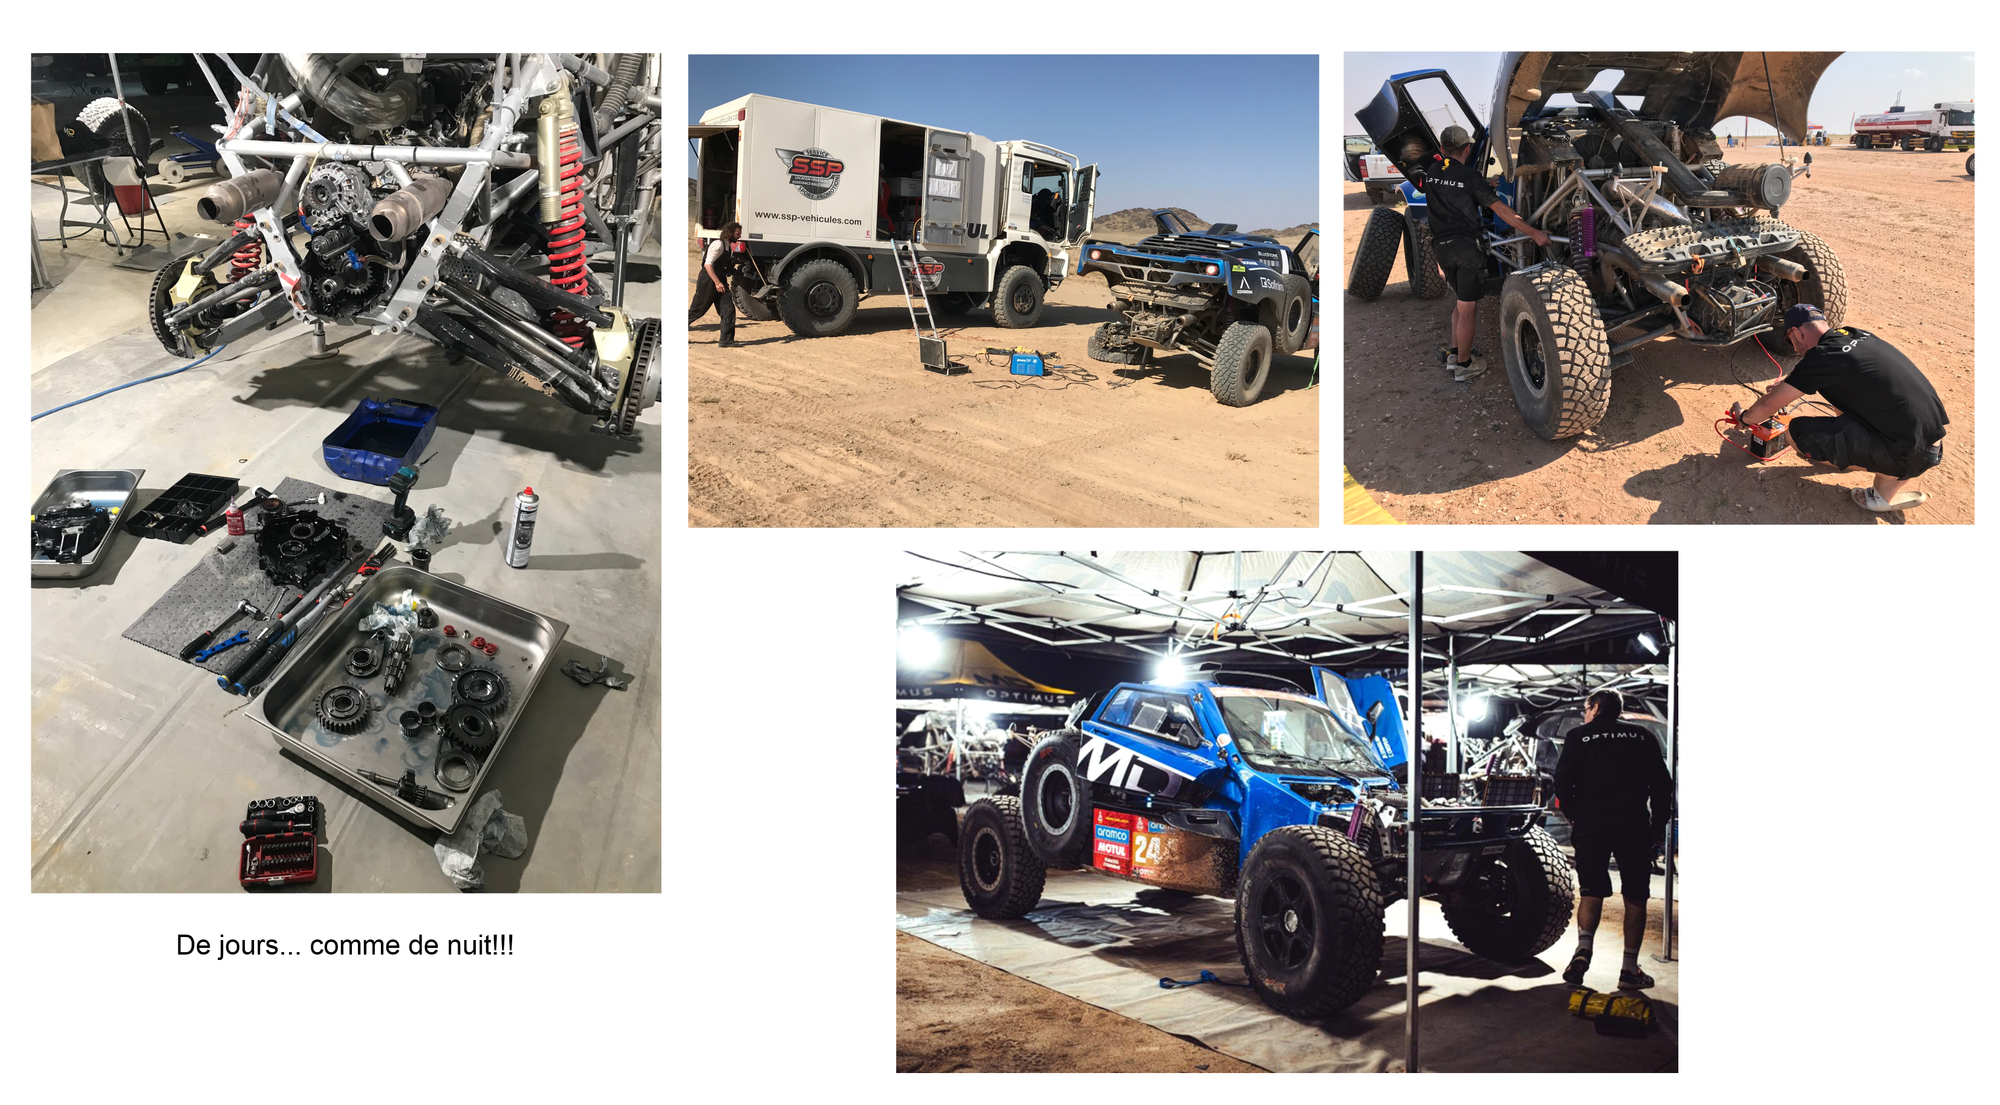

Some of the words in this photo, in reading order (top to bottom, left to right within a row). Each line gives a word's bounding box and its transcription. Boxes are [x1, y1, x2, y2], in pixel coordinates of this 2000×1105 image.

[791, 157, 843, 176] SSP
[754, 211, 862, 226] www.ssp-vehicules.com
[966, 222, 989, 239] UL
[985, 689, 1067, 704] OPTIMUS
[1097, 827, 1127, 841] aramco
[1098, 841, 1126, 857] MOTUL
